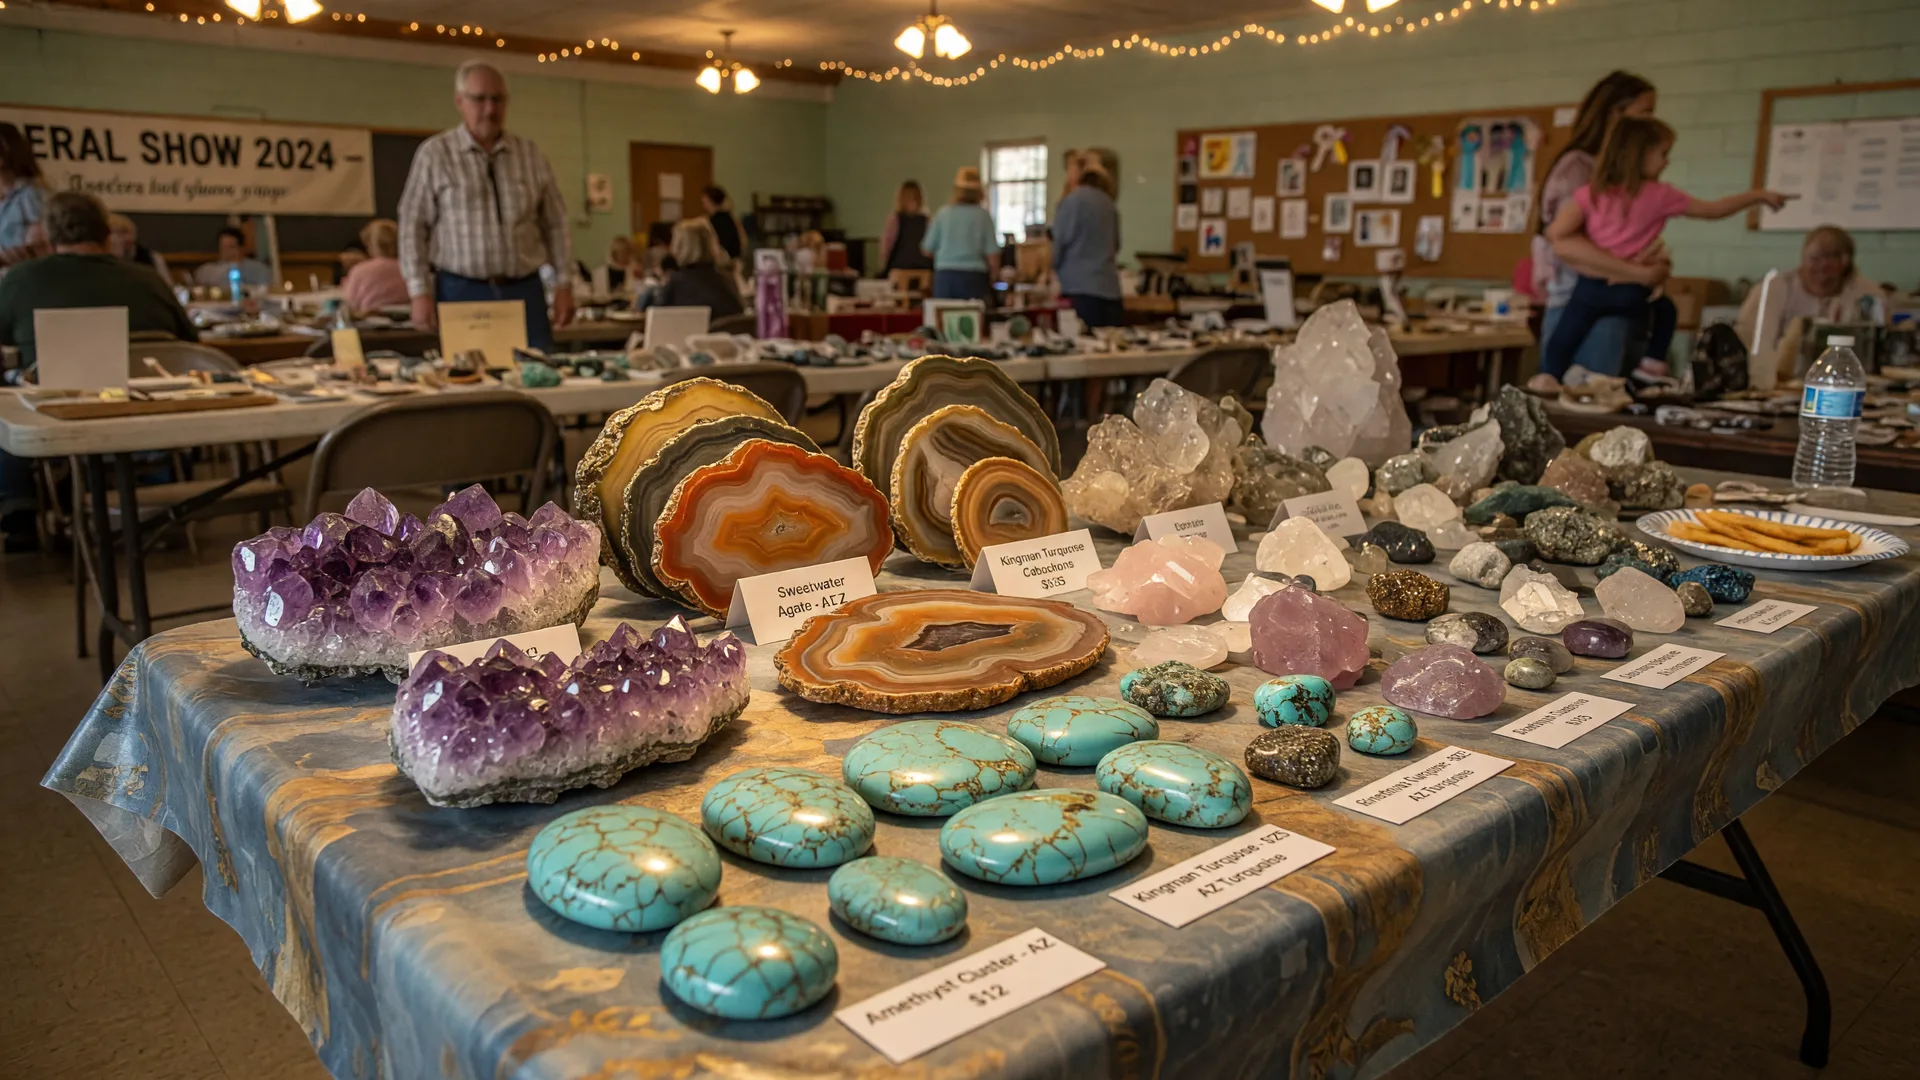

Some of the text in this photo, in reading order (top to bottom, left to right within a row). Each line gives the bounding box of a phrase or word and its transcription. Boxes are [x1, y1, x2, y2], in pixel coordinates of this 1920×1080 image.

[140, 130, 242, 167] SHOW
[254, 136, 335, 171] 2024
[778, 601, 813, 618] Agate
[1133, 870, 1201, 903] Kingman
[1197, 882, 1223, 898] AZ
[865, 979, 958, 1027] Amethyst
[1031, 935, 1057, 957] AZ
[968, 982, 1010, 1008] $12
